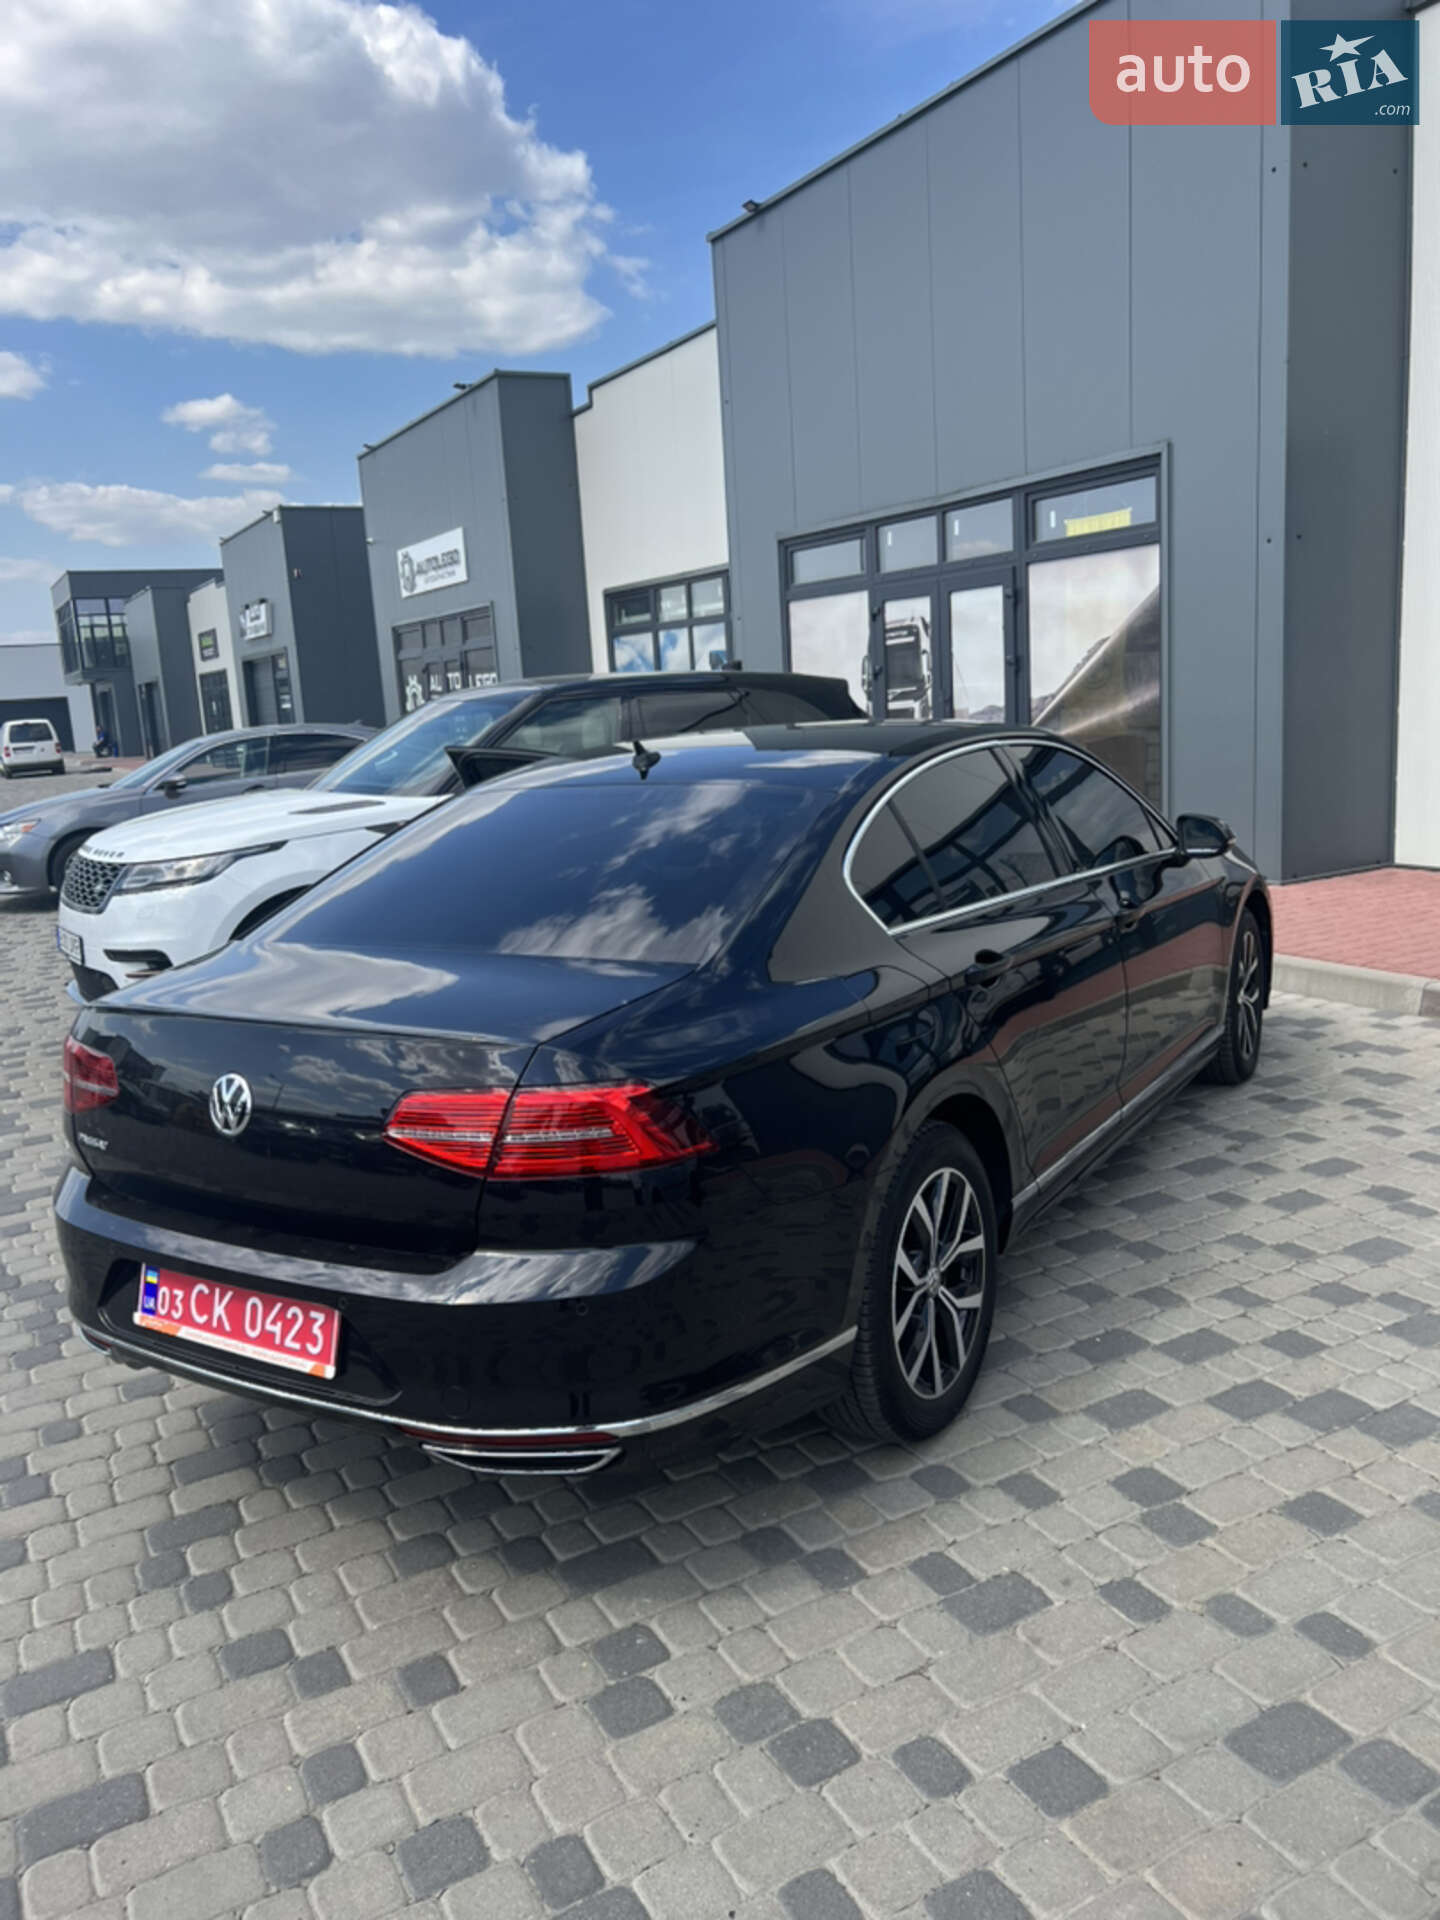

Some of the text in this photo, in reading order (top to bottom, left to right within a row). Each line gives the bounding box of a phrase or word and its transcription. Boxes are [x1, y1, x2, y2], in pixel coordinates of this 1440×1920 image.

[158, 1286, 185, 1320] 03
[190, 1283, 234, 1332] CK
[245, 1296, 326, 1355] 0423
